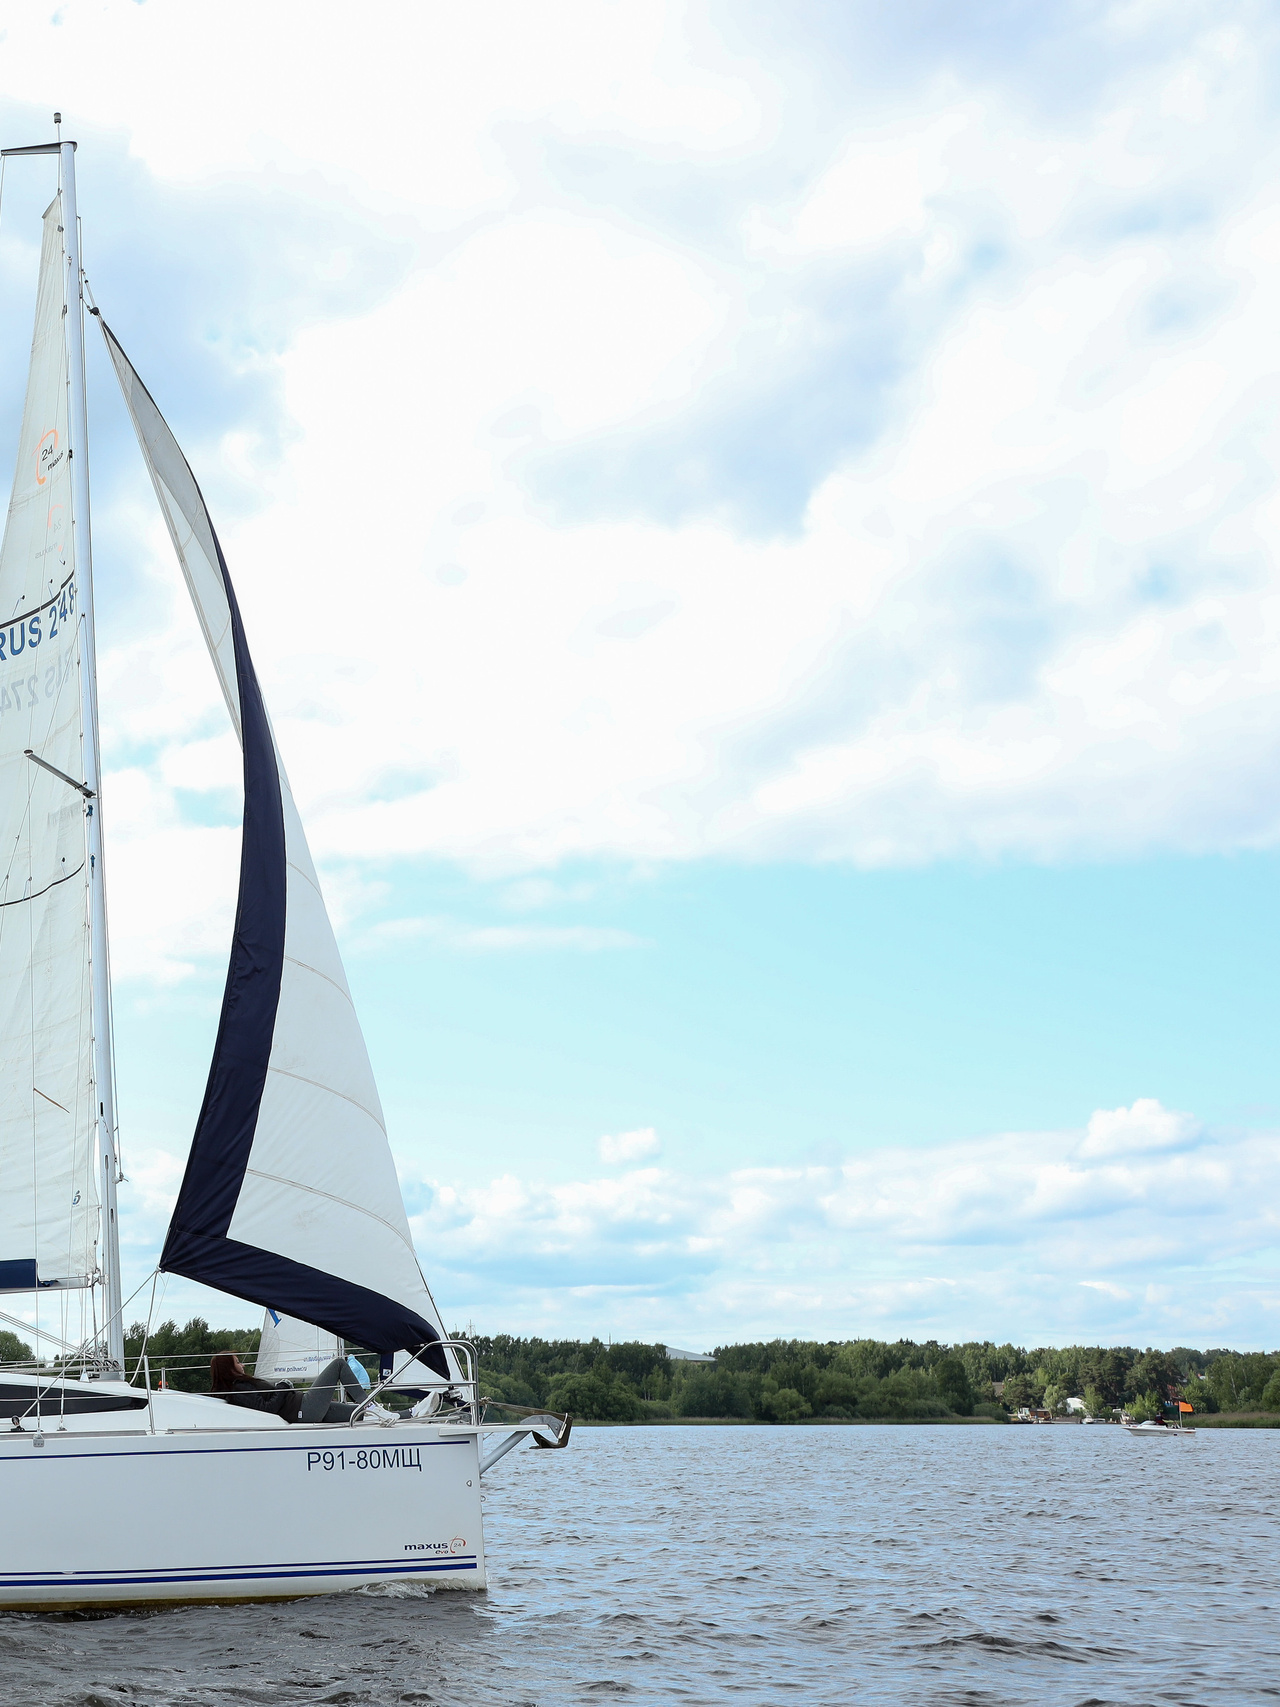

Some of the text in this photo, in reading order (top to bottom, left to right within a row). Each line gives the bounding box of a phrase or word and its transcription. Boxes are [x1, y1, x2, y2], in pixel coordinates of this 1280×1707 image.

[41, 444, 53, 461] 24
[307, 1448, 422, 1472] Р91-80МЩ
[404, 1542, 448, 1551] maxus
